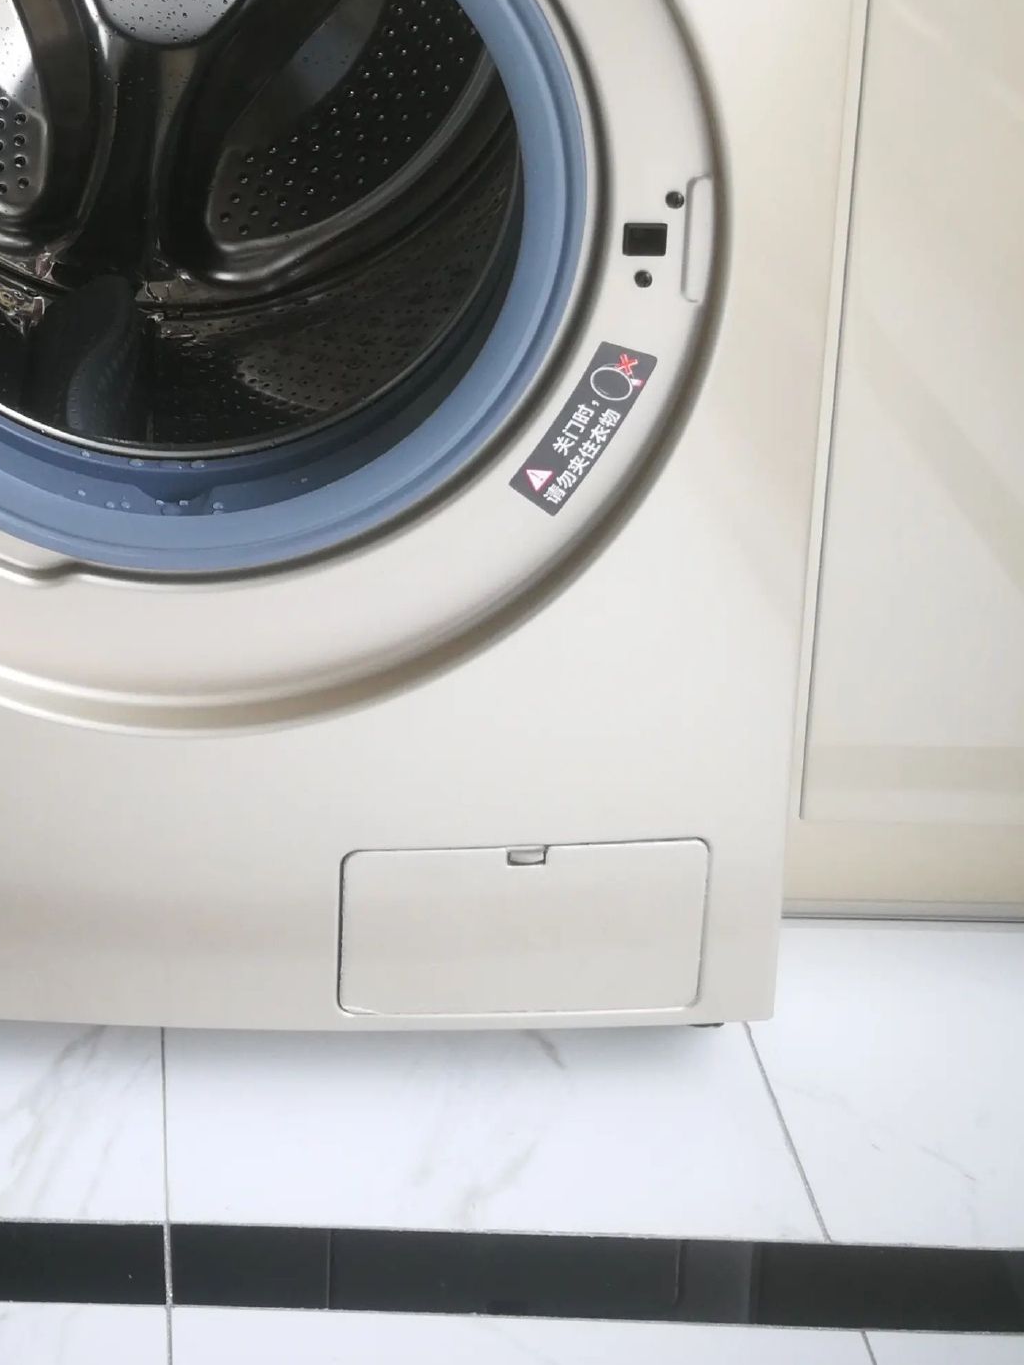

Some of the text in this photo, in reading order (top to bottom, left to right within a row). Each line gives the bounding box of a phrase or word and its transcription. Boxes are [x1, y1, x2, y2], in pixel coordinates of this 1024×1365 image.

[543, 408, 621, 504] 请勿夹住衣物
